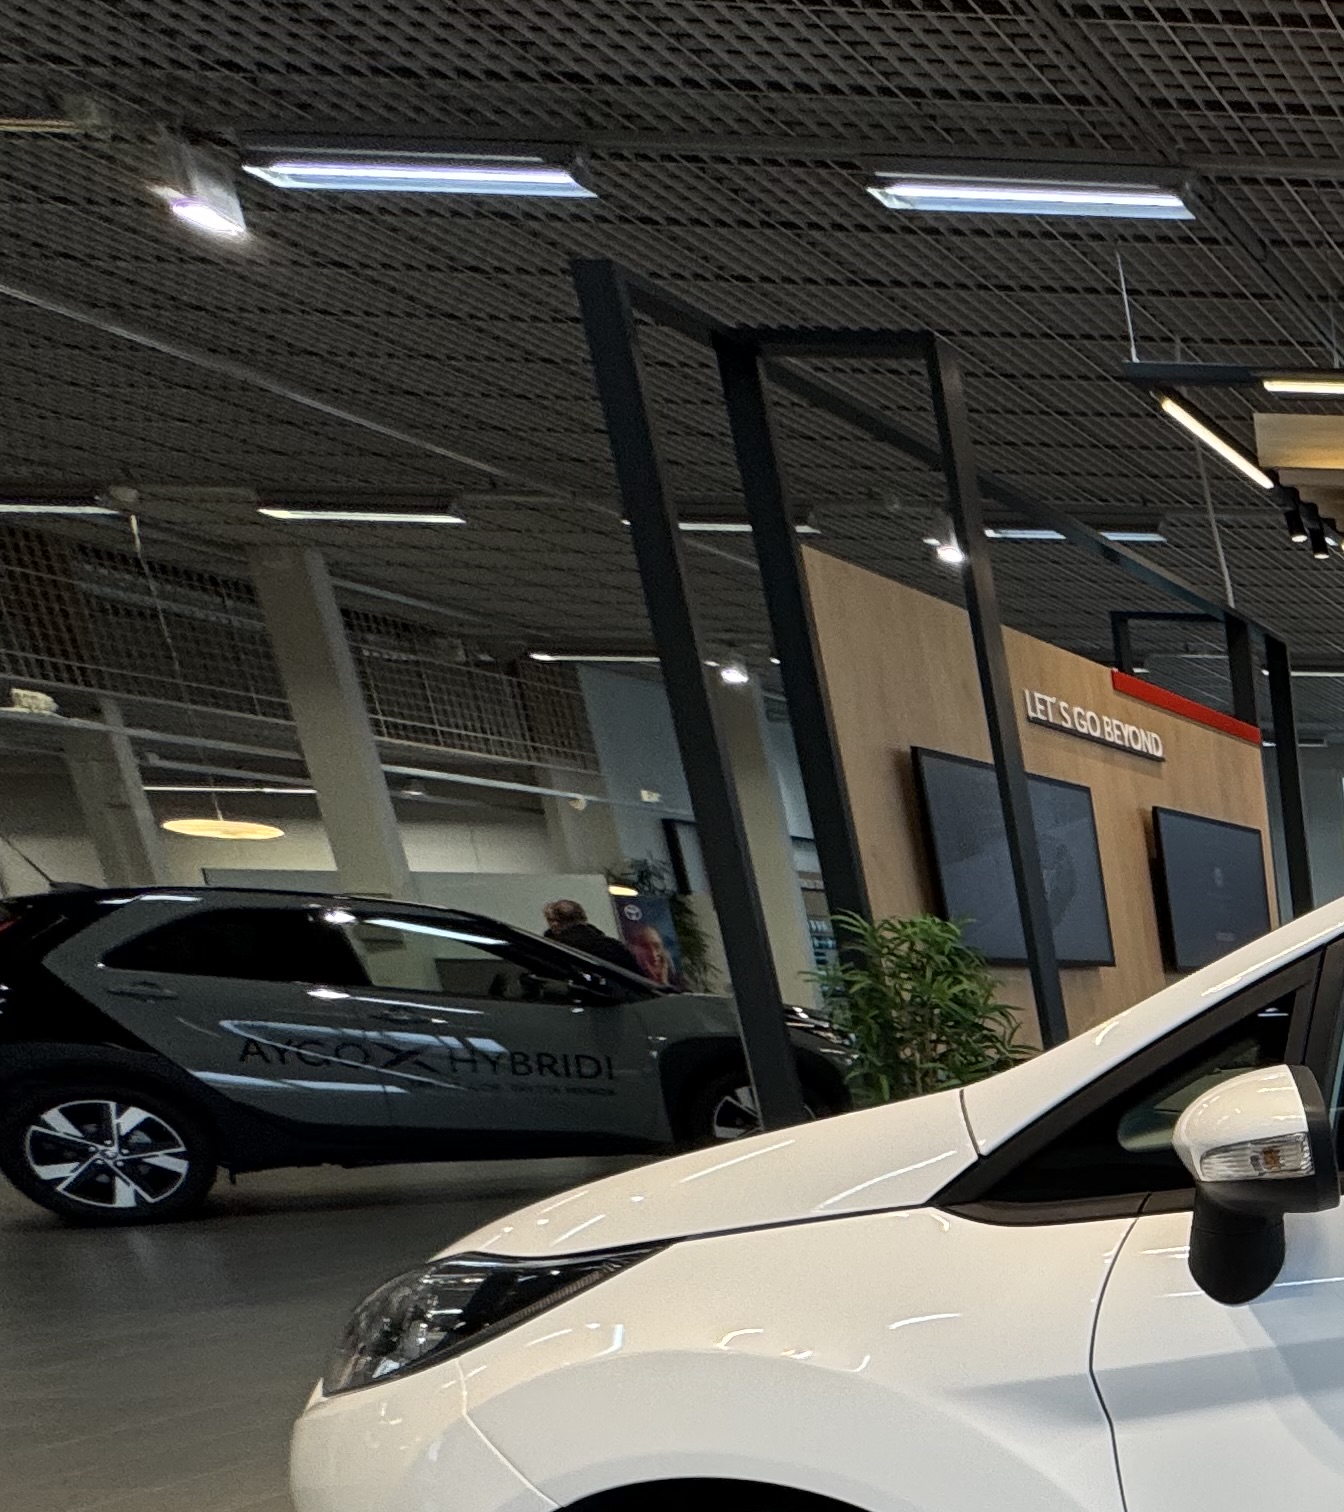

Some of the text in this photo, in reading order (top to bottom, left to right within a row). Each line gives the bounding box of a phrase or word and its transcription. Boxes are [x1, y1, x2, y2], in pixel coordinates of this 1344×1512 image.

[1072, 706, 1100, 737] GO
[1101, 715, 1164, 758] BEYOND
[448, 1046, 614, 1081] HYBRIDI
